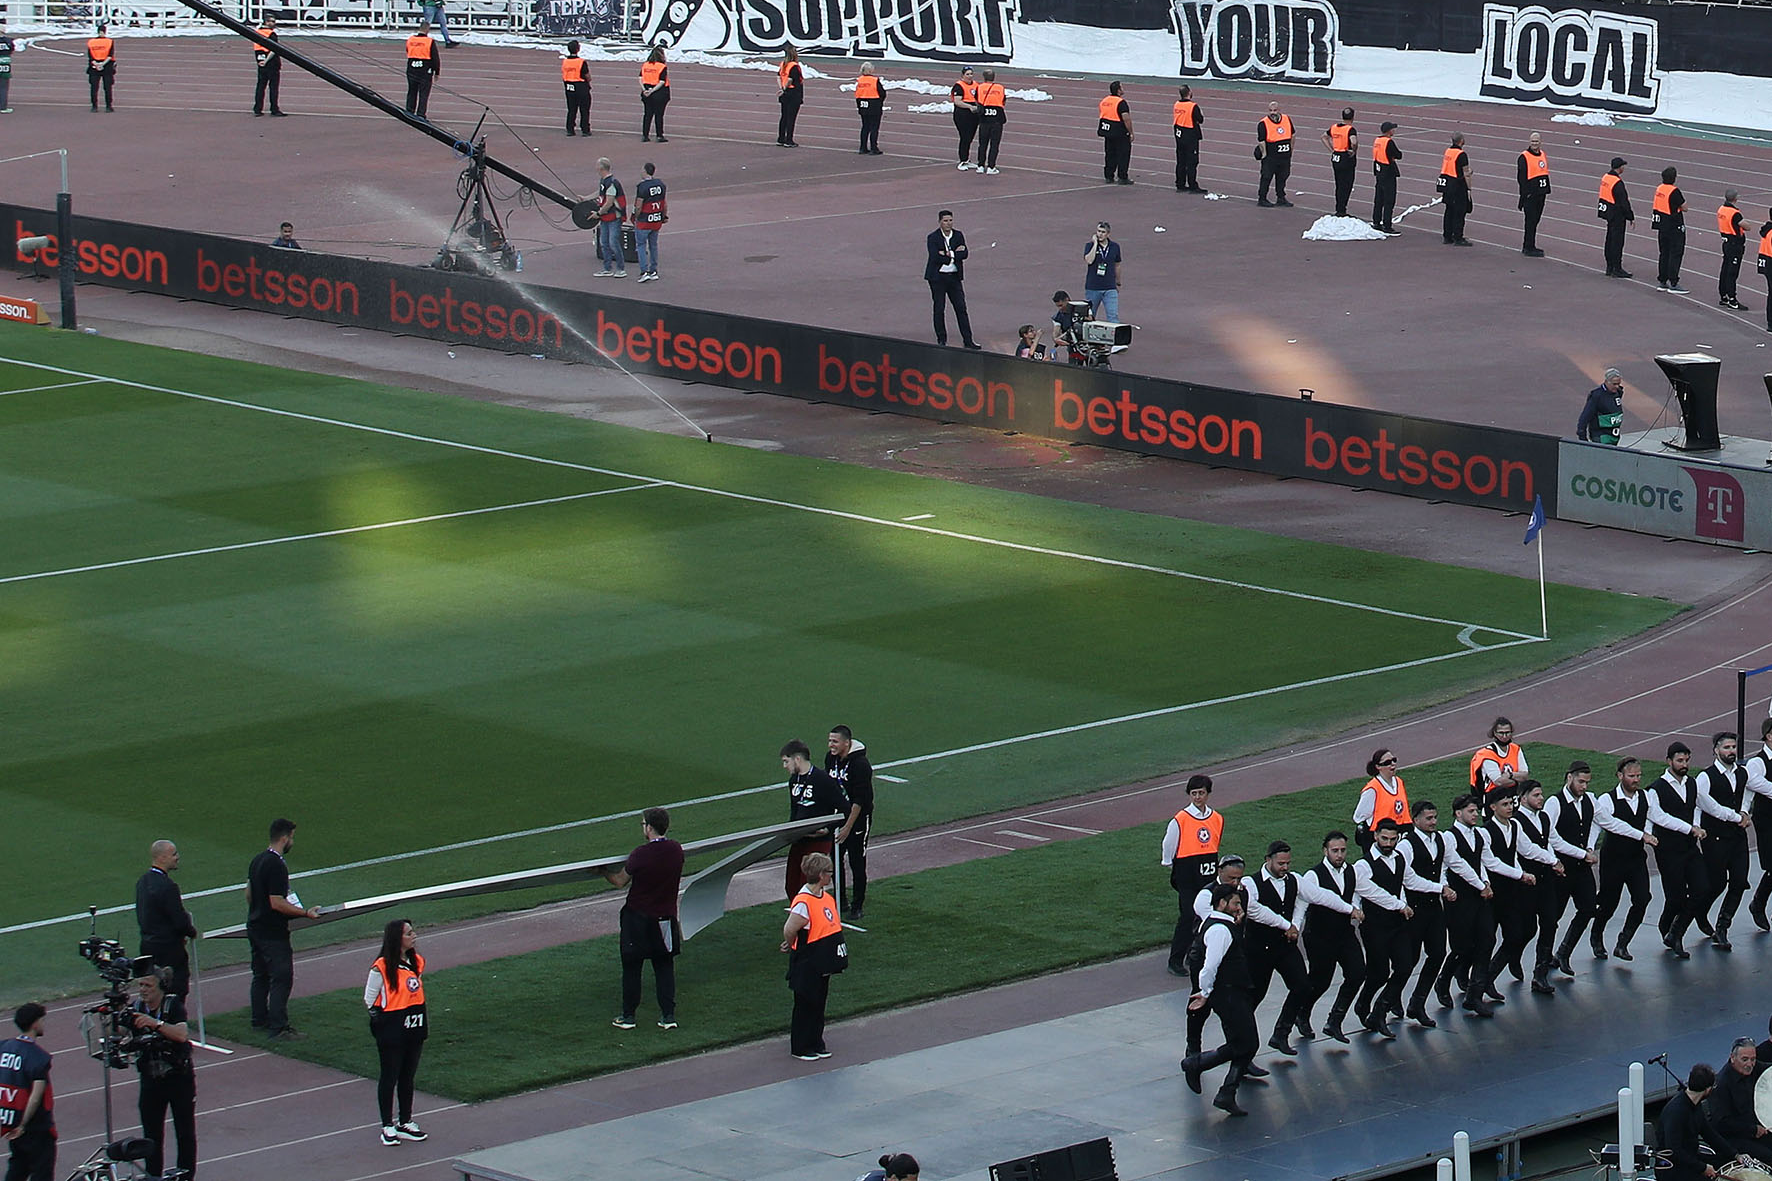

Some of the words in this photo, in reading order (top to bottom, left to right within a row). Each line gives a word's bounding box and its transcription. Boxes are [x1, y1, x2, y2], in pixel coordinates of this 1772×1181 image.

[1492, 6, 1656, 101] LOCAL
[985, 106, 998, 117] 330
[1278, 144, 1290, 154] 225
[15, 220, 169, 286] besson
[196, 249, 360, 316] betsson
[389, 278, 563, 349] betsson
[597, 310, 783, 385] betsson
[818, 343, 1016, 421] betsson
[1053, 379, 1264, 460] betsson
[1304, 417, 1535, 502] betsson
[1570, 472, 1684, 514] COSMOTE
[403, 1013, 424, 1029] 421
